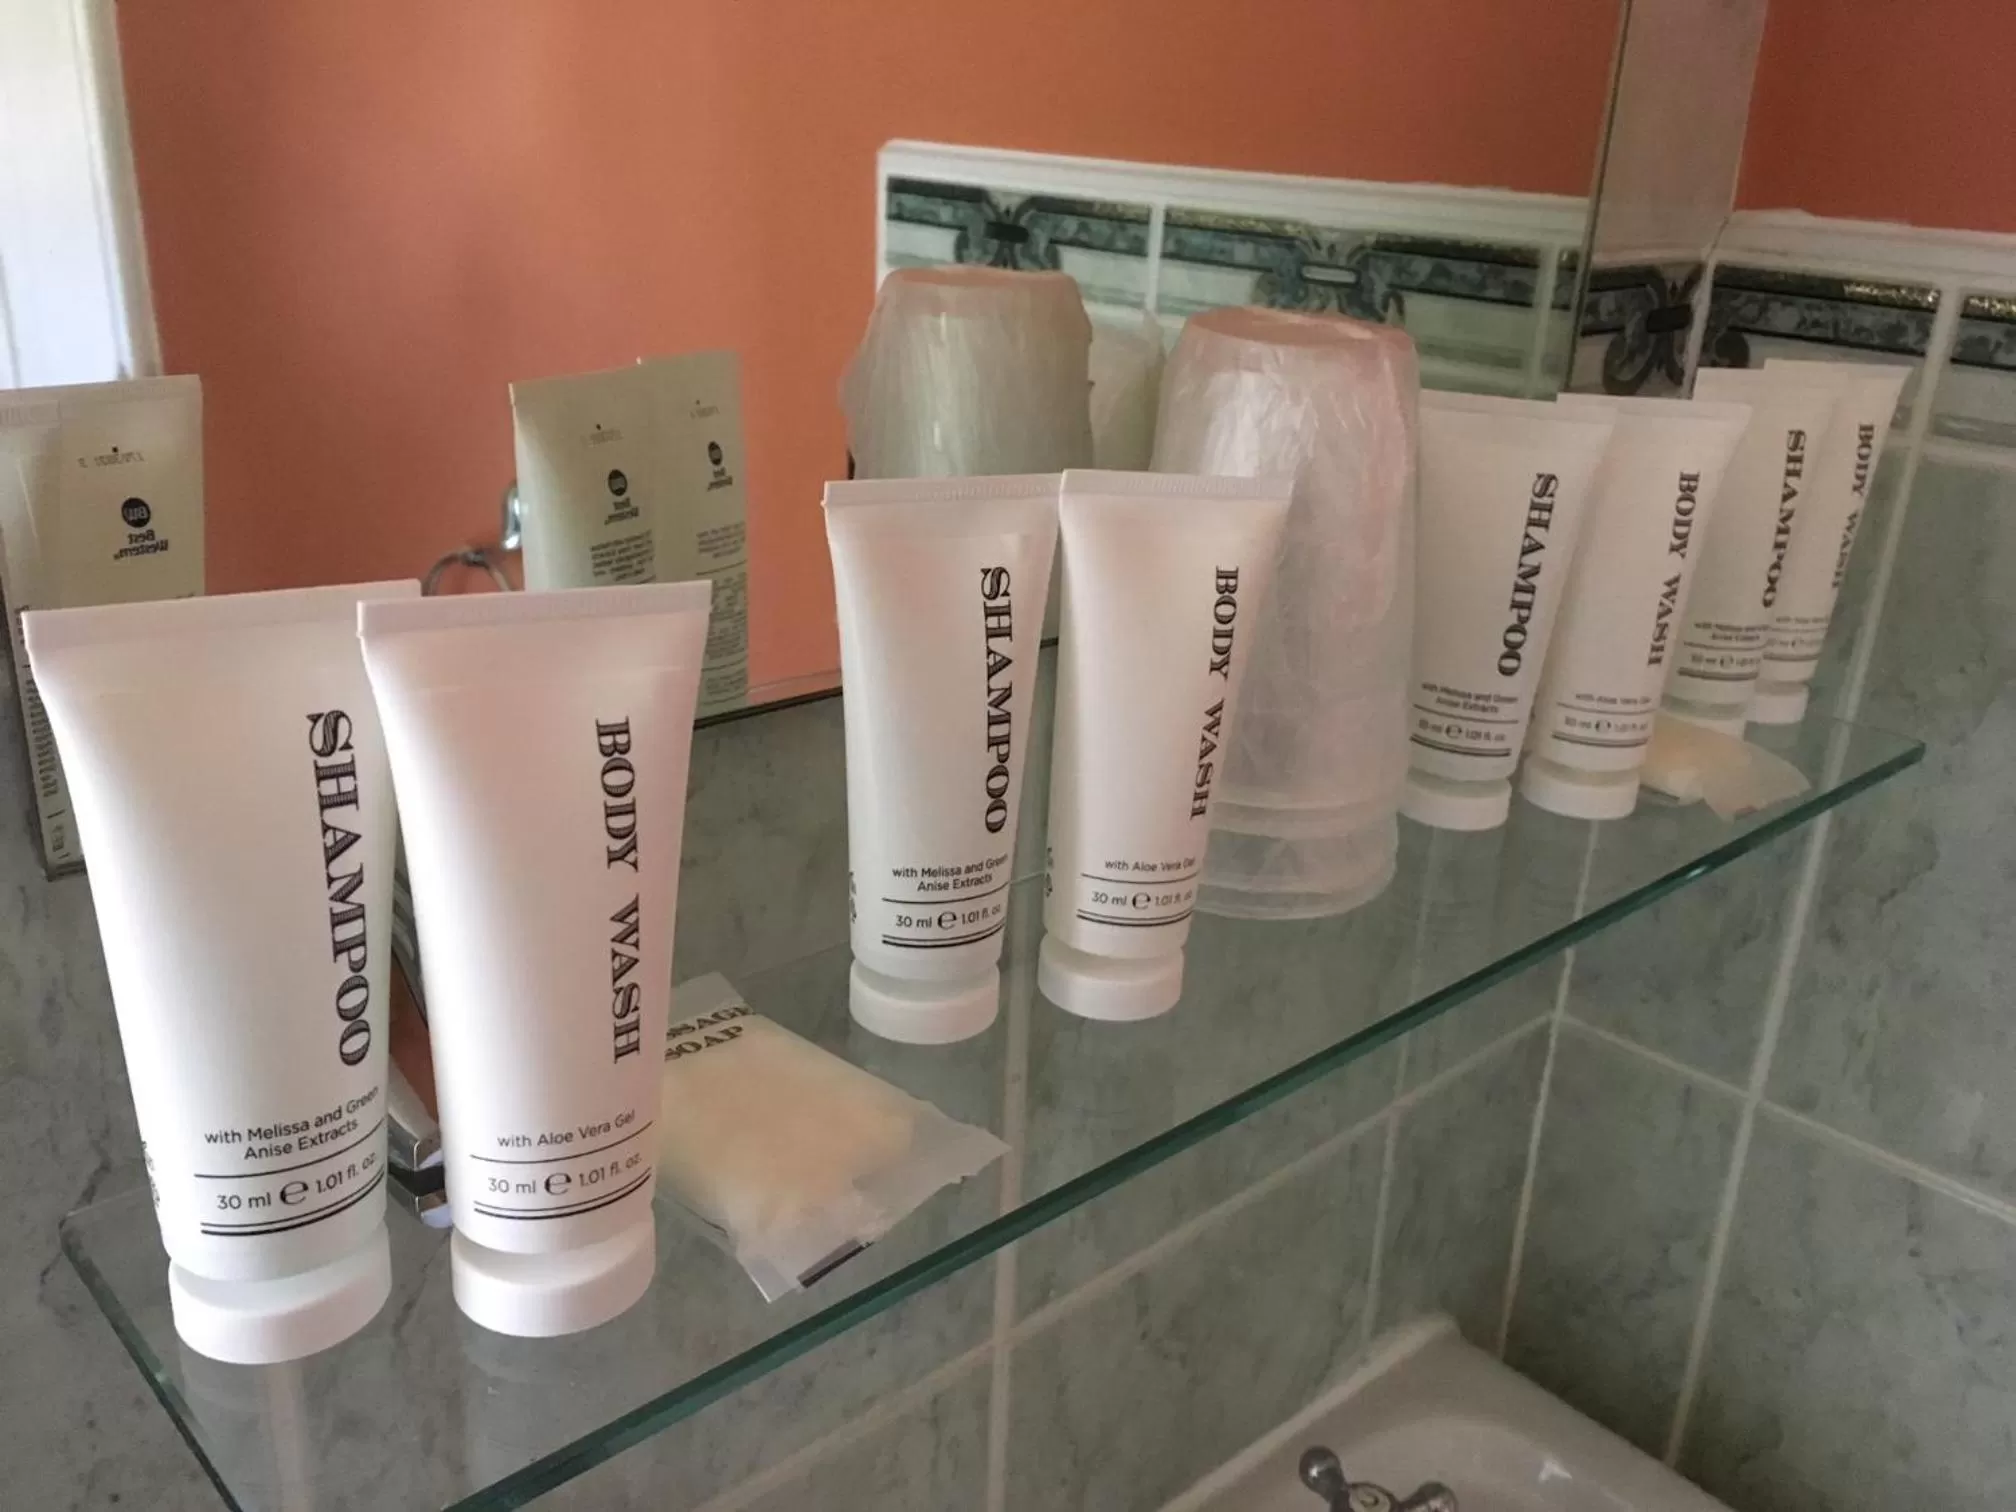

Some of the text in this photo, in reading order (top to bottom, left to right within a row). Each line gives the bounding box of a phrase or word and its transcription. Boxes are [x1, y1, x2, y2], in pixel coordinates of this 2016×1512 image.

[1762, 429, 1806, 609] SHAMPOO
[1497, 472, 1560, 677] SHAMPOO
[1647, 471, 1701, 667] BODY WASH
[981, 565, 1014, 835] SHAMPOO
[1190, 564, 1240, 821] BODY WASH
[892, 867, 918, 878] with
[921, 865, 962, 878] Melissa
[964, 861, 984, 875] and
[917, 873, 993, 892] Anise Extracts
[1104, 859, 1129, 871] with
[1131, 861, 1158, 872] Aloe
[306, 709, 371, 1067] SHAMPOO
[595, 715, 641, 1065] BODY WASH
[1091, 890, 1109, 905] 30
[1111, 895, 1128, 906] ml
[895, 914, 913, 928] 30
[916, 916, 933, 929] ml
[204, 1085, 379, 1144] with Melissa and Green
[497, 1108, 636, 1148] with Aloe Vera Gel
[243, 1118, 359, 1160] Anise Extracts
[216, 1194, 242, 1211] 30
[247, 1191, 272, 1209] ml
[315, 1170, 344, 1194] 1.01
[487, 1177, 510, 1194] 30
[515, 1179, 537, 1194] ml
[578, 1167, 606, 1188] 1.01
